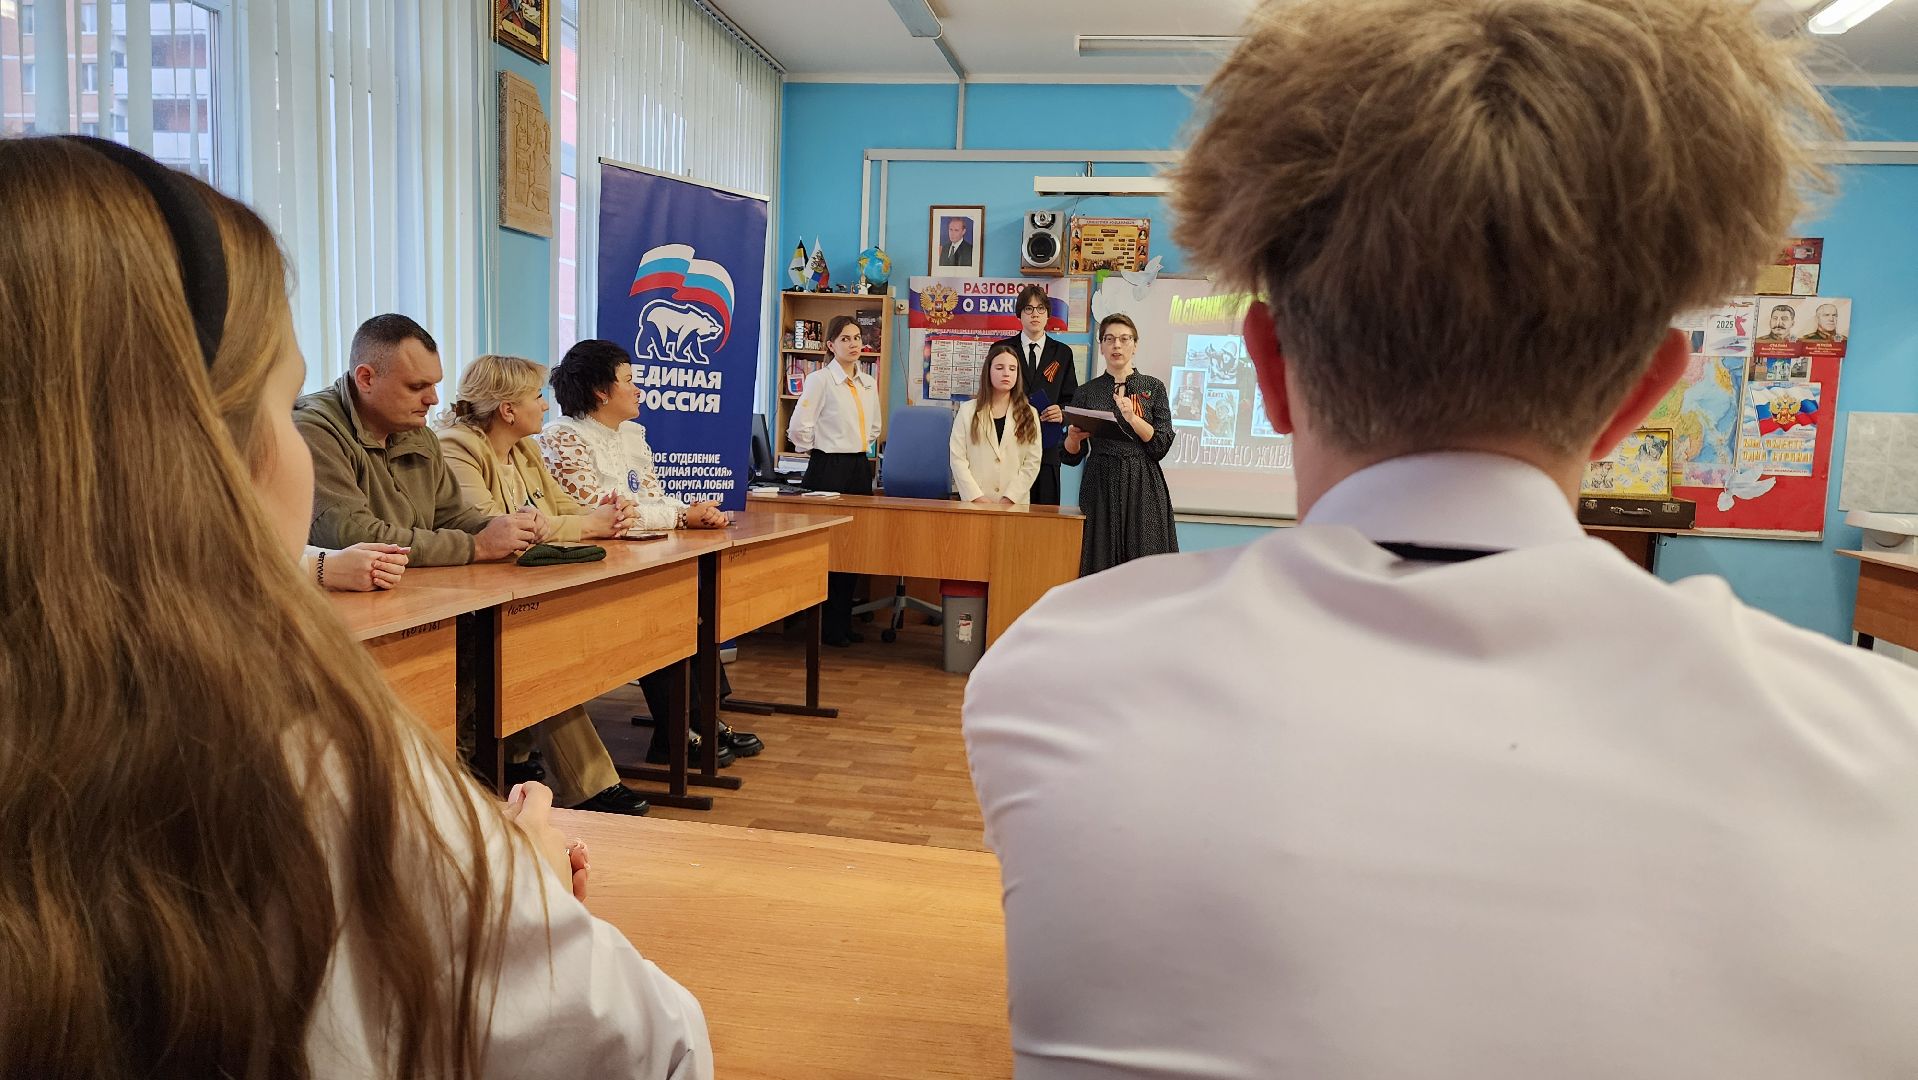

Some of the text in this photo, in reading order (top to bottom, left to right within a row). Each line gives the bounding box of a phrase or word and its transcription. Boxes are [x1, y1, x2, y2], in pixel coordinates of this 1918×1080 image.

[962, 298, 975, 312] О
[1716, 320, 1734, 329] 2025
[630, 363, 722, 390] ЕДИНАЯ
[668, 453, 721, 465] ОТДЕЛЕНИЕ
[691, 467, 733, 478] РОССИЯ»
[667, 480, 702, 490] ОКРУГА
[703, 480, 735, 490] ЛОБНЯ
[683, 492, 724, 503] ОБЛАСТИ
